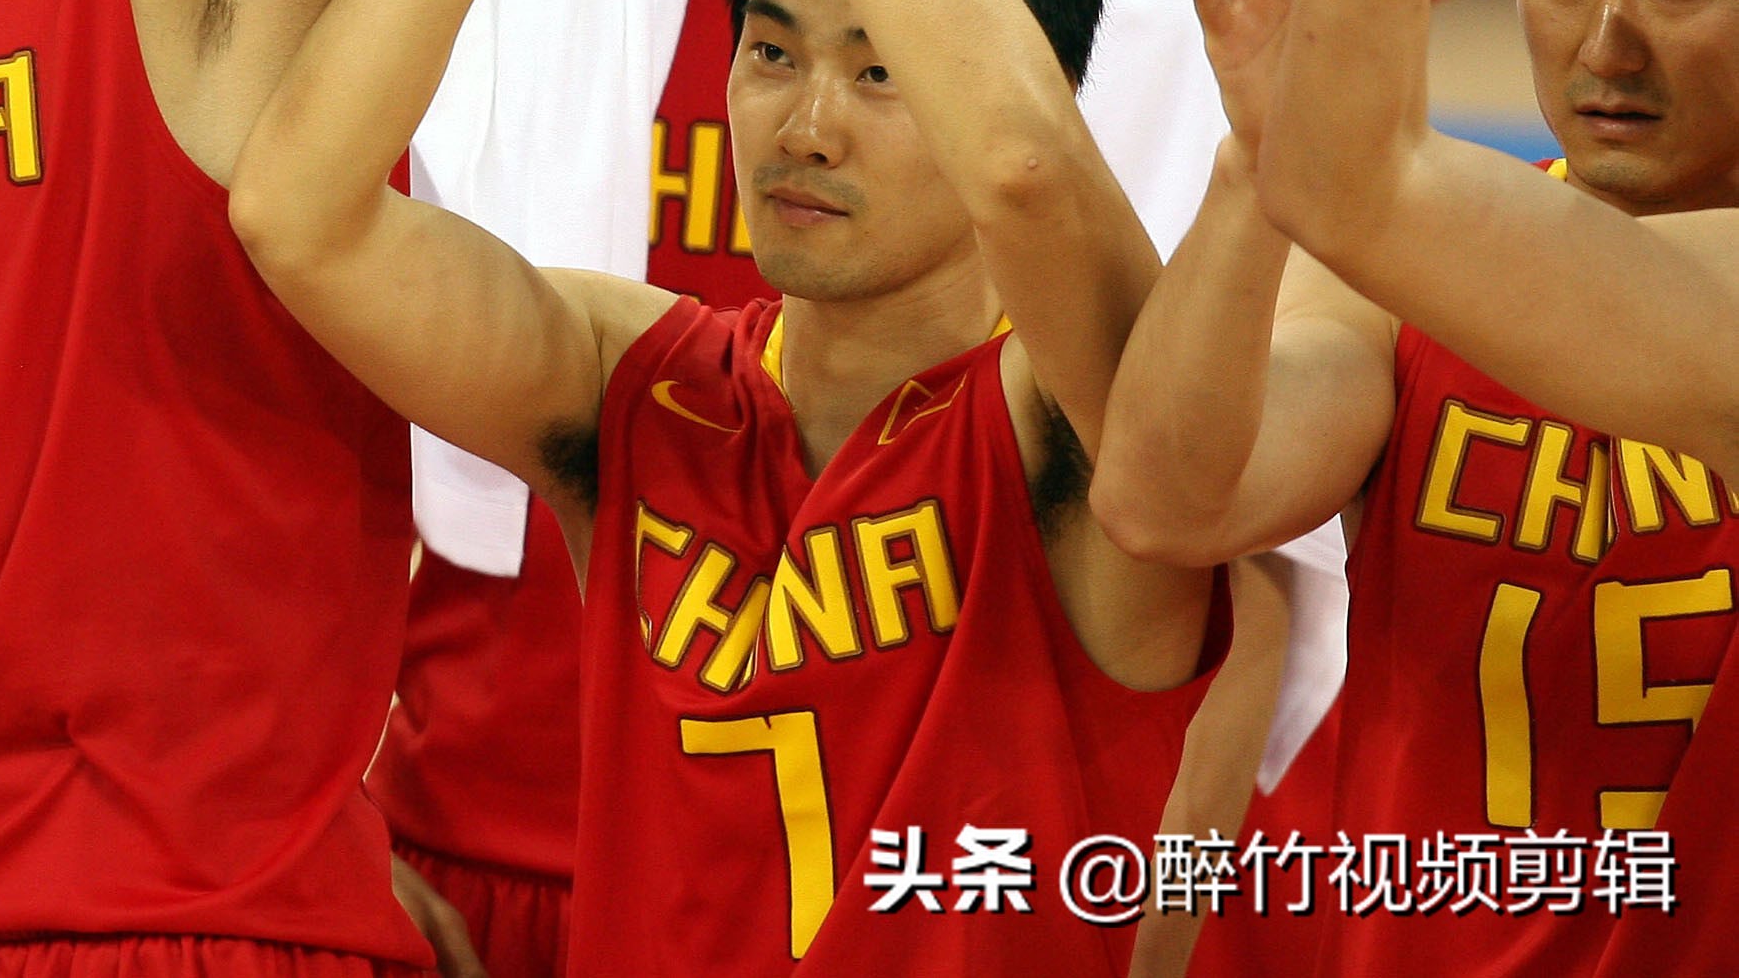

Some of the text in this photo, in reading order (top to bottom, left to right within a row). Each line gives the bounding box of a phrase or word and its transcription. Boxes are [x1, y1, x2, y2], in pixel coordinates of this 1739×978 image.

[1415, 398, 1739, 563] CHN
[635, 498, 961, 693] CHNA
[1478, 567, 1735, 830] 15
[680, 709, 834, 960] 7
